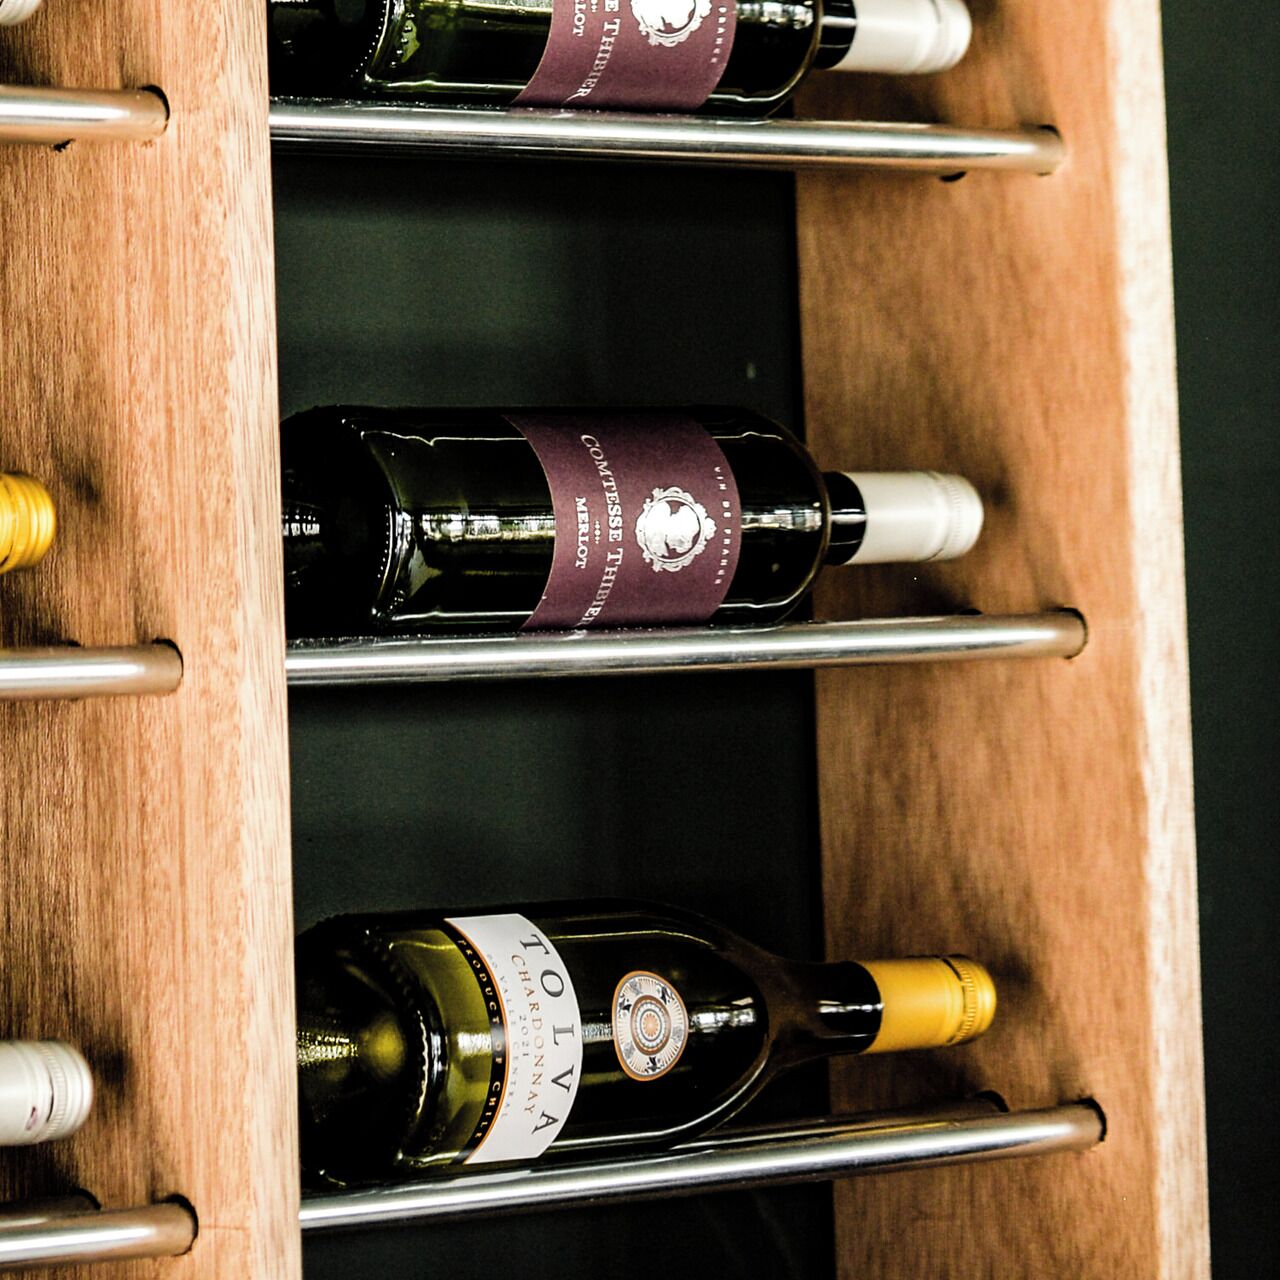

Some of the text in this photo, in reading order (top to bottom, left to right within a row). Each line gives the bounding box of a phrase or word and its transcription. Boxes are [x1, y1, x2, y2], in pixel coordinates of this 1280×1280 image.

[562, 17, 621, 106] THIBIER
[580, 433, 624, 543] COMTESSE
[575, 496, 591, 570] MERLOT
[456, 938, 501, 1026] PRODUCT
[510, 953, 545, 1115] CHARDONNAY
[519, 932, 576, 1136] TOLVA
[519, 1014, 531, 1058] 2021
